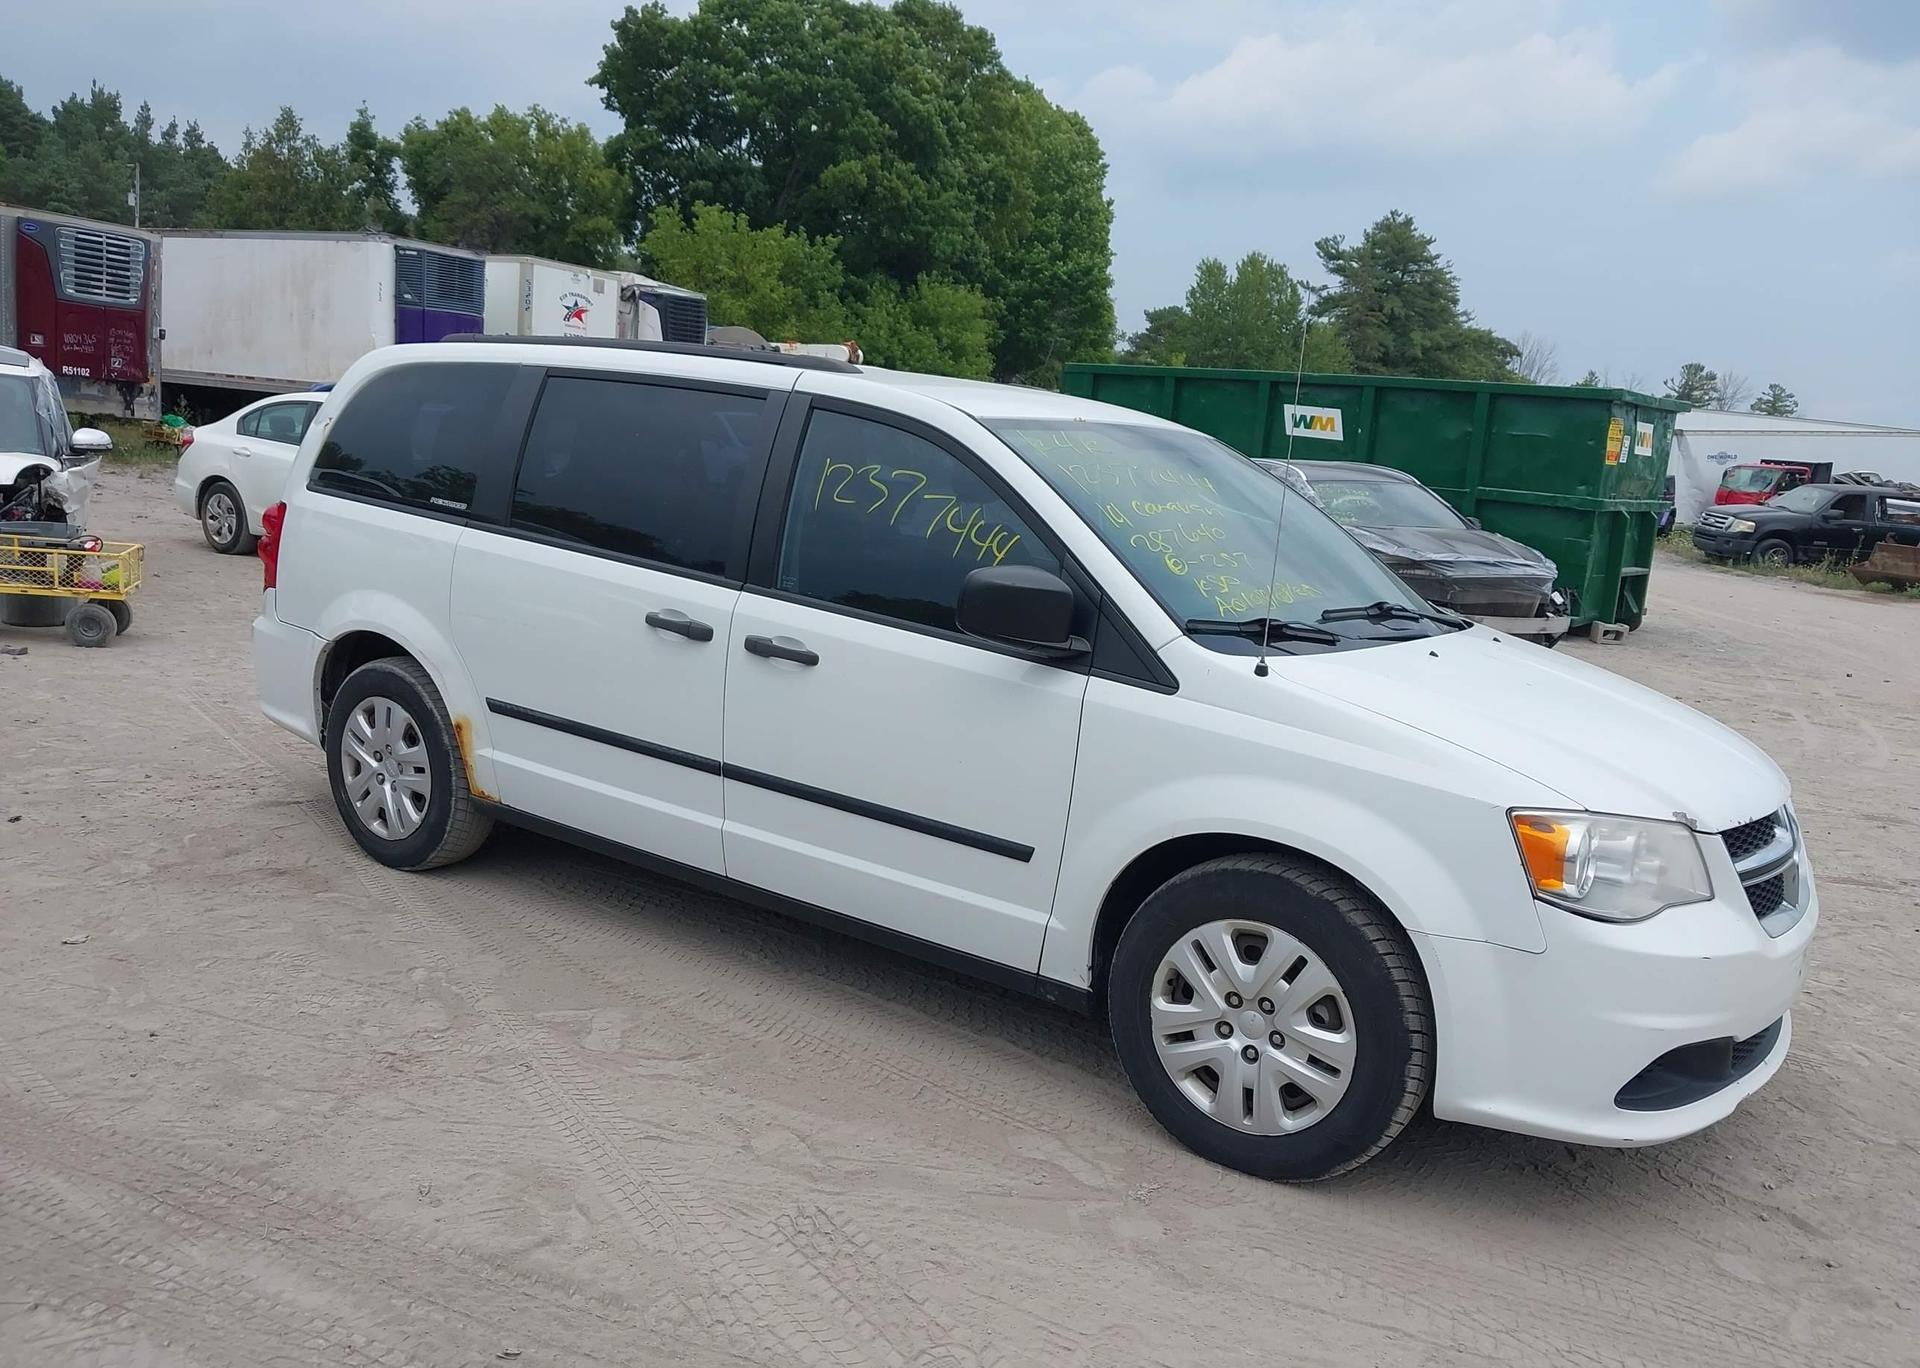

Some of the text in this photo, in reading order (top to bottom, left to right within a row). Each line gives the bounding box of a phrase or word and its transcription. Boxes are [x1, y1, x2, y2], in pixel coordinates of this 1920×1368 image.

[62, 365, 90, 377] R51102
[1291, 413, 1336, 432] WM
[815, 458, 1021, 567] 12377444
